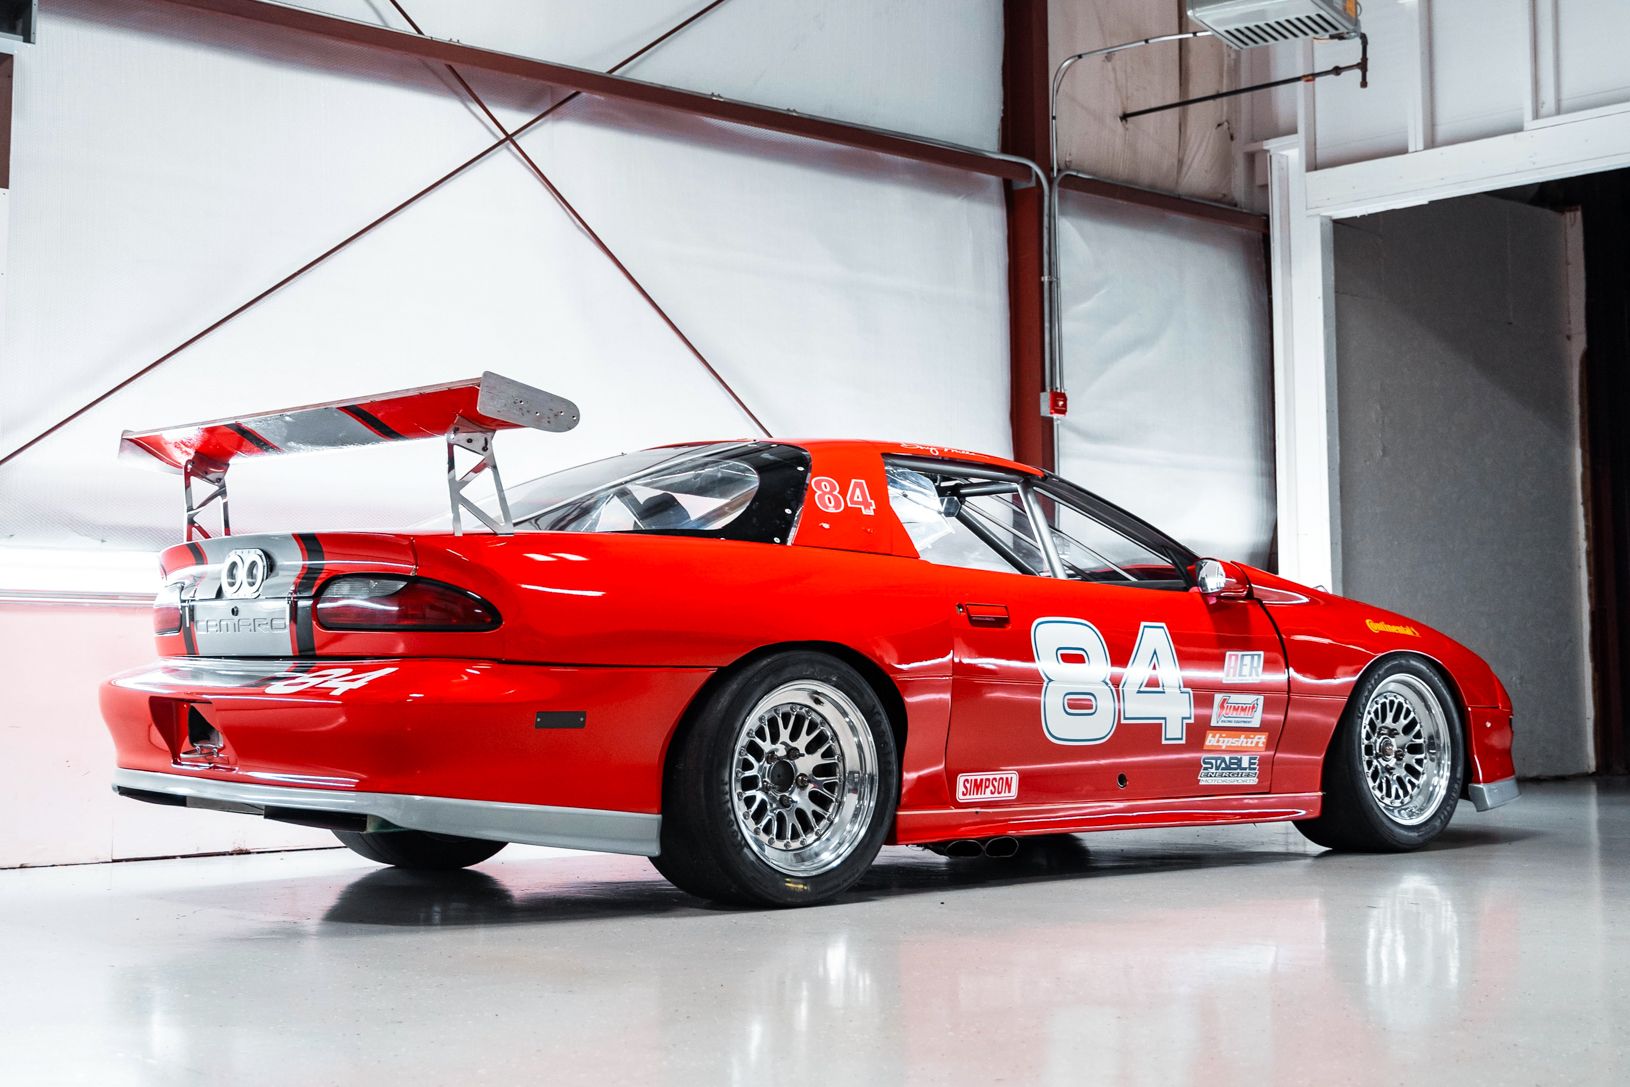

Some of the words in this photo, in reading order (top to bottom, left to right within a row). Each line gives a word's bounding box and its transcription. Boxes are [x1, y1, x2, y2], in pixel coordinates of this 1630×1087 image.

[811, 476, 876, 516] 84
[264, 667, 400, 696] 84
[1030, 616, 1195, 746] 84
[1205, 733, 1266, 750] blipshift
[1202, 755, 1259, 771] STABLE
[961, 776, 1013, 797] SIMPSON
